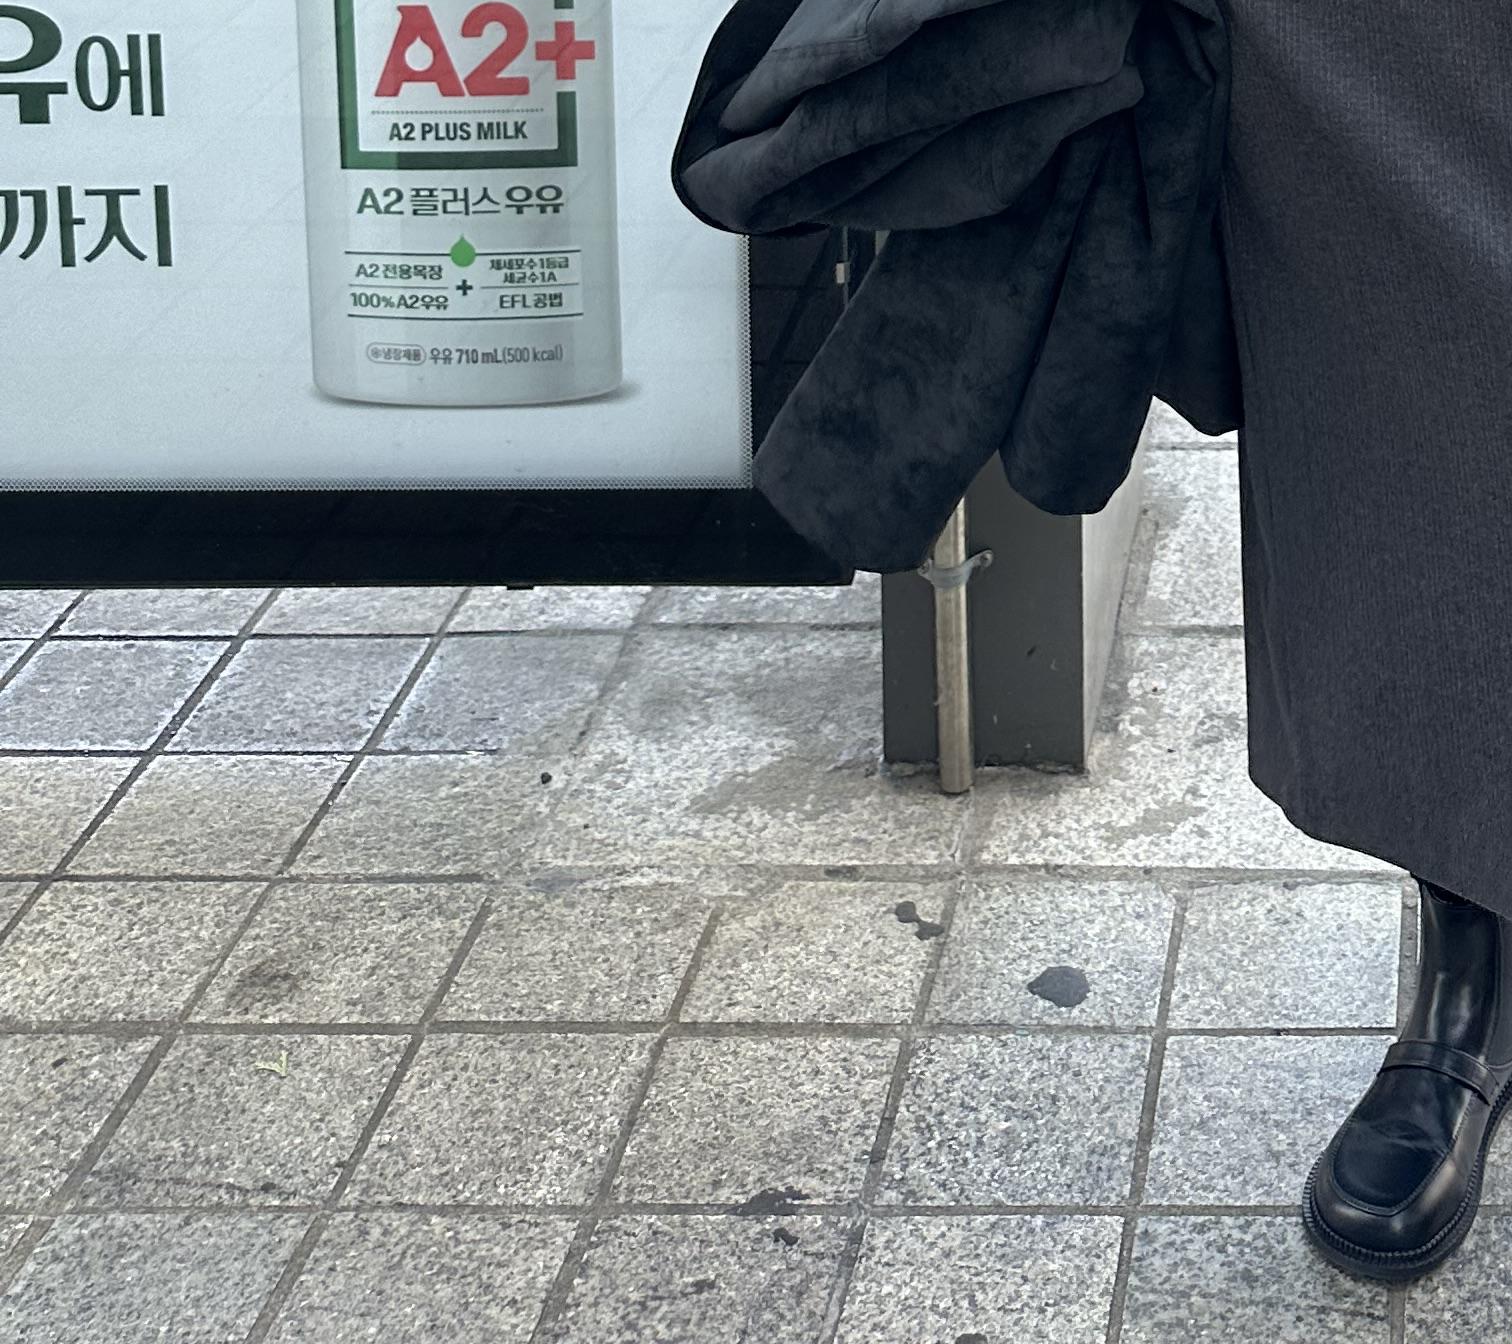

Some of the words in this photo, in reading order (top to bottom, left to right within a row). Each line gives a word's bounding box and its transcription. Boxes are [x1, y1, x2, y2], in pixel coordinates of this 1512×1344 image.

[389, 122, 415, 141] A2
[421, 122, 471, 141] PLUS
[477, 121, 528, 140] MILK
[430, 347, 453, 365] 우유
[455, 348, 478, 364] 710
